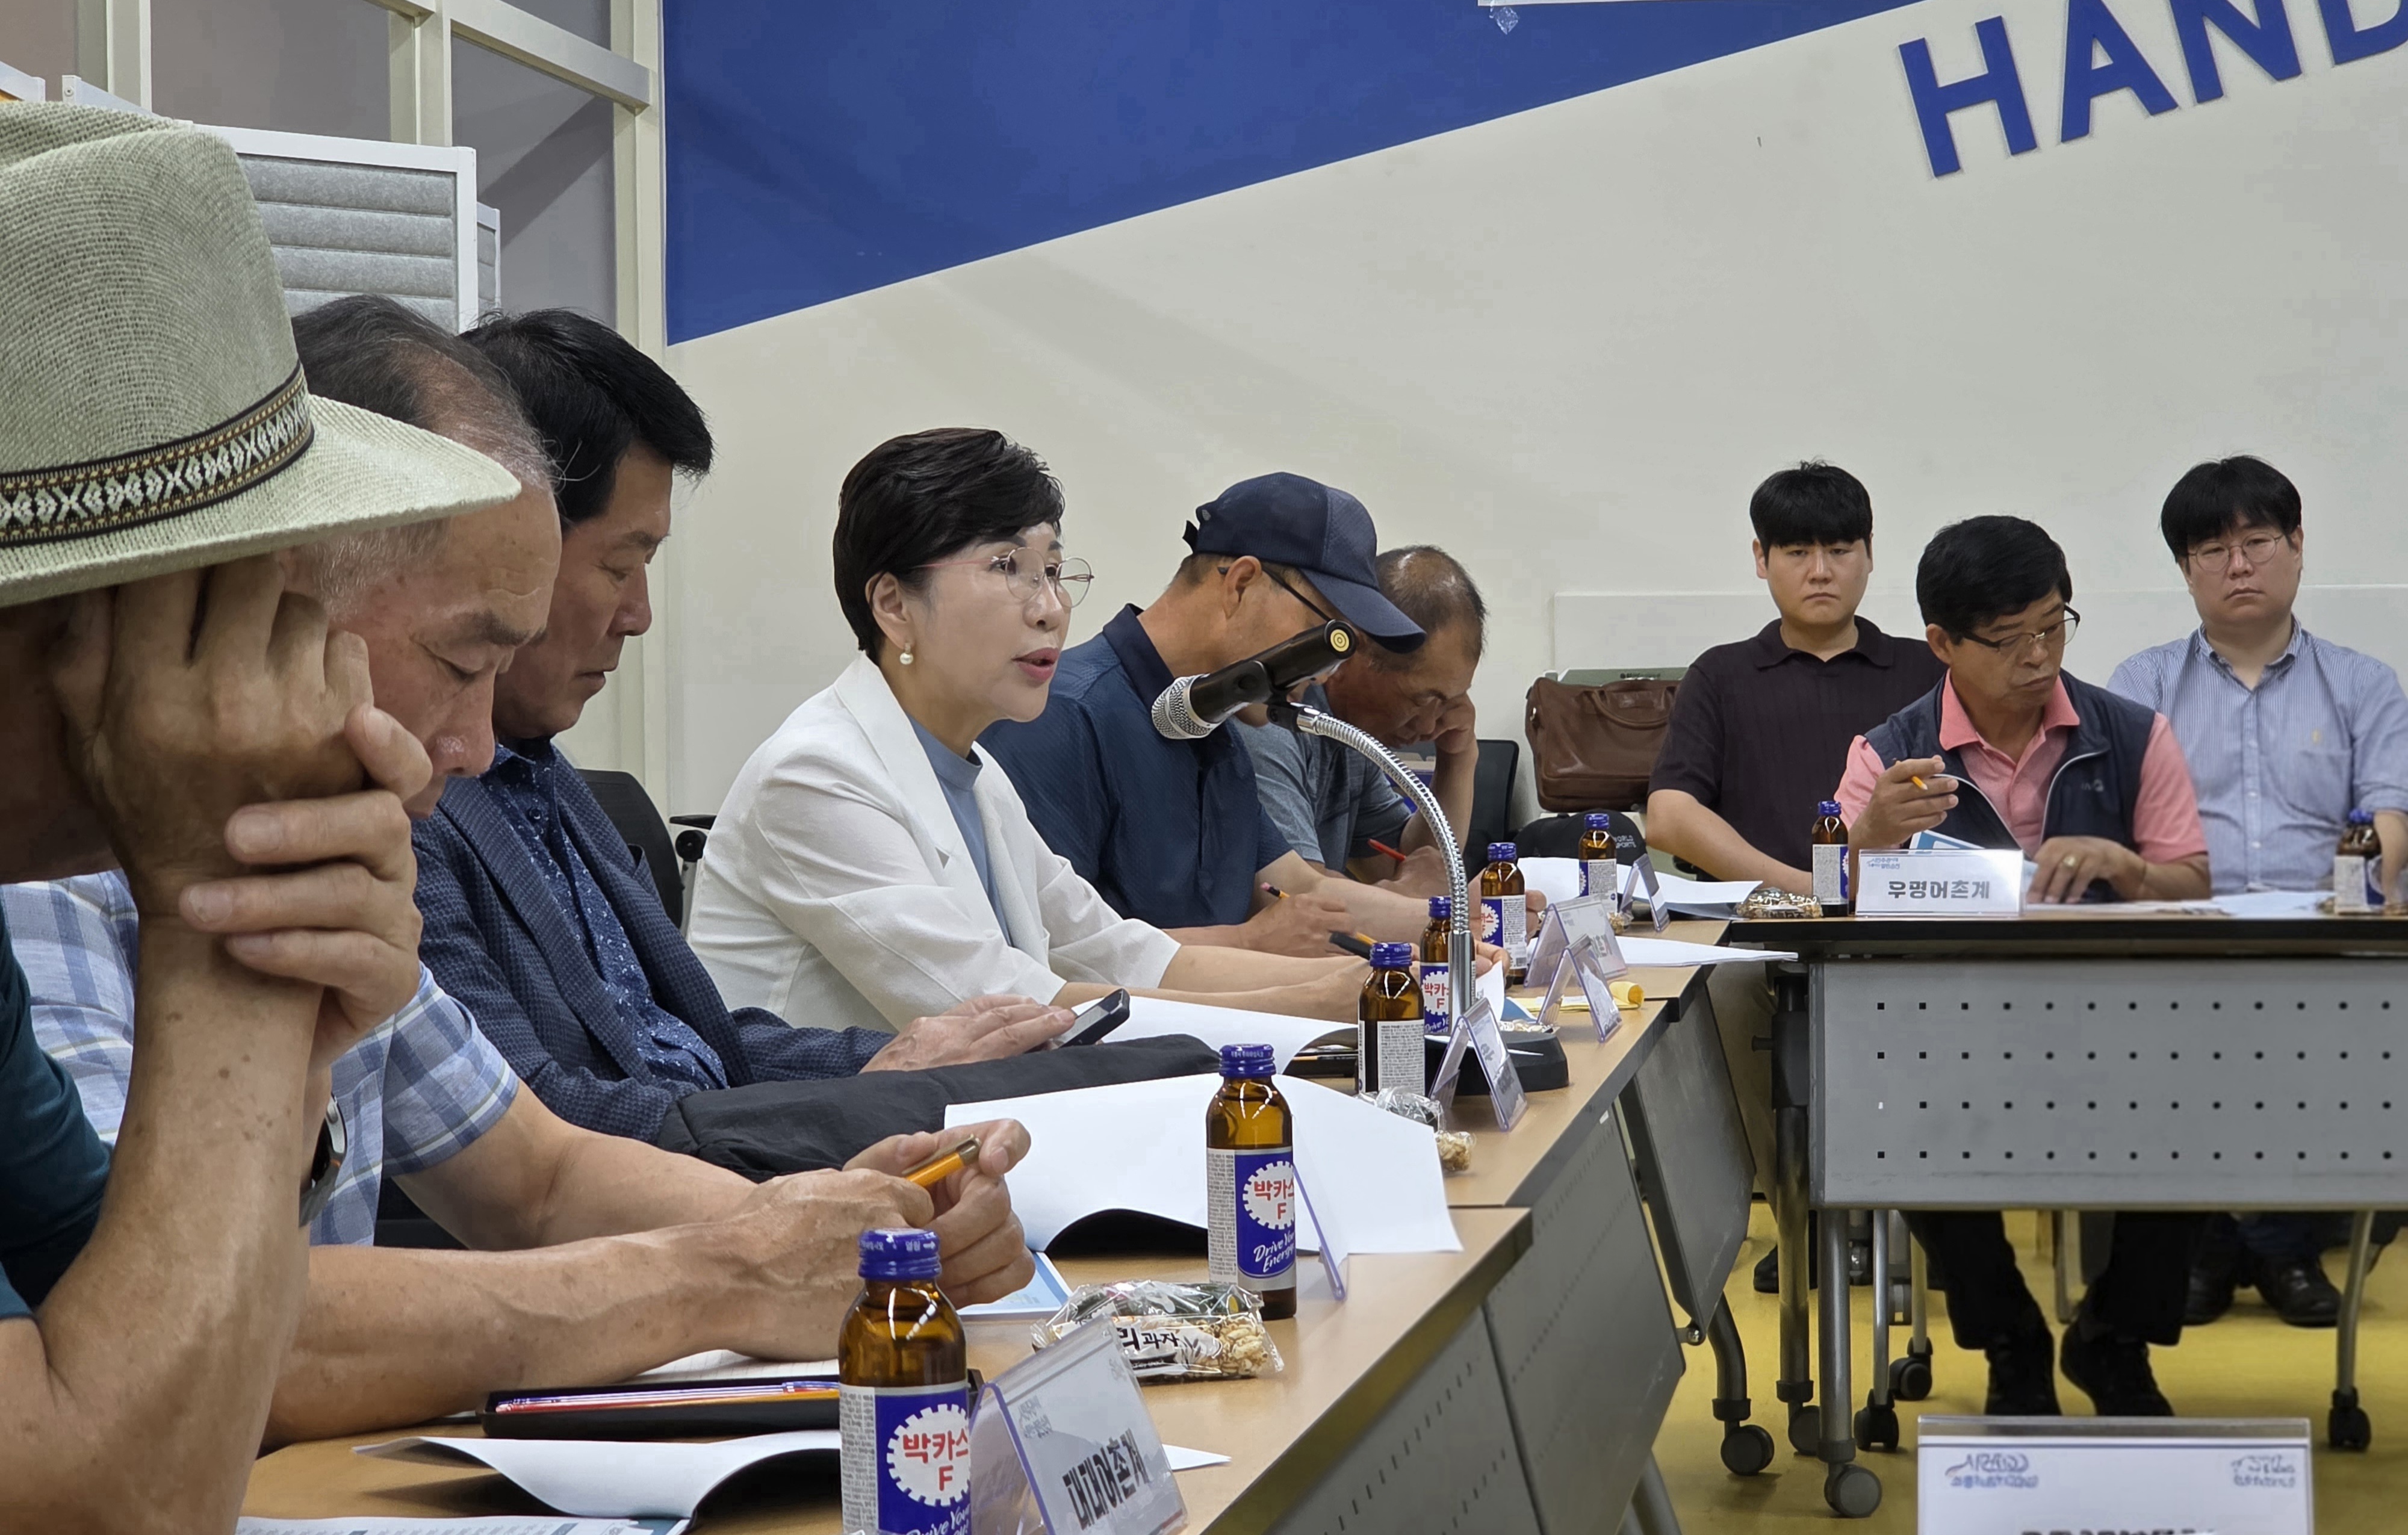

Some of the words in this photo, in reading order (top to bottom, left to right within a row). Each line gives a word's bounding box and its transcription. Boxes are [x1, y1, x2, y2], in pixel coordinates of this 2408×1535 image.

[1888, 879, 1990, 899] 우명어촌계
[1424, 983, 1449, 996] 박카
[1436, 998, 1445, 1009] F
[1277, 1203, 1286, 1220] F
[1253, 1239, 1283, 1262] Drive
[902, 1427, 969, 1463] 박카스
[939, 1465, 954, 1491] F
[1062, 1427, 1150, 1530] 대대어촌계
